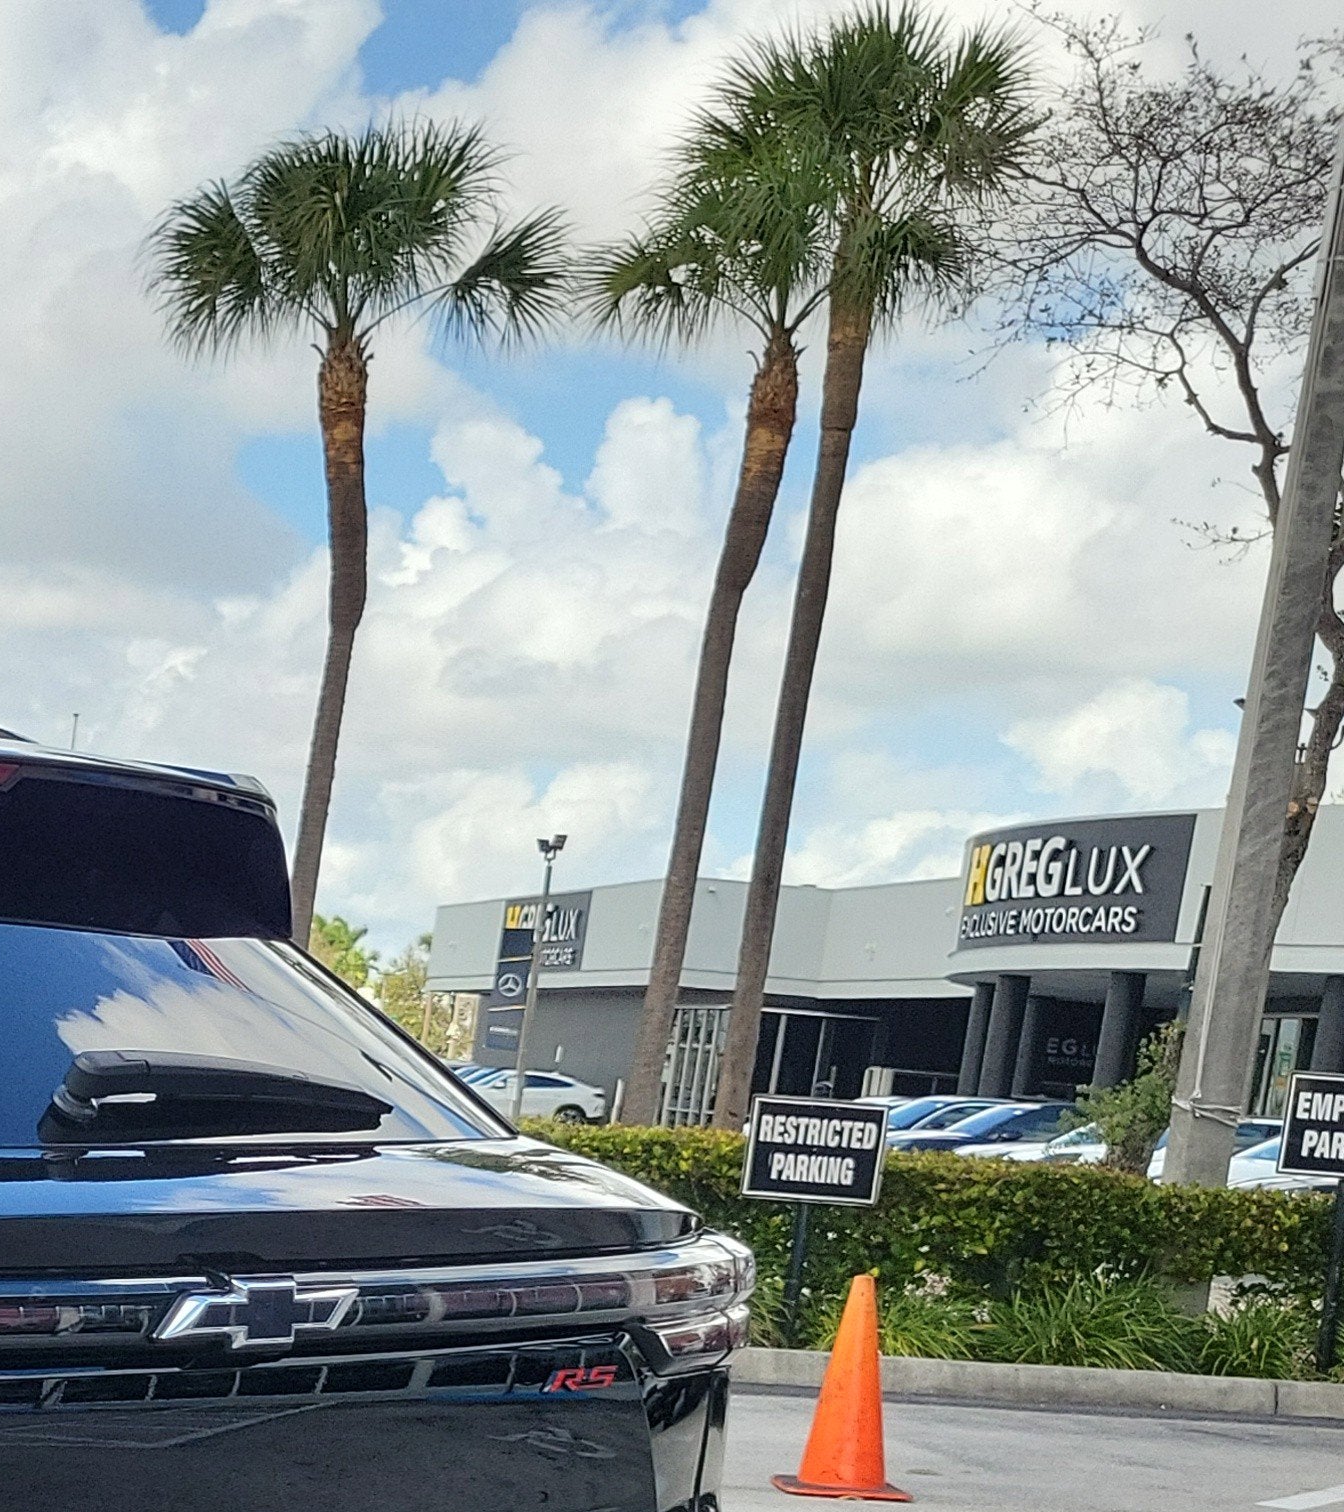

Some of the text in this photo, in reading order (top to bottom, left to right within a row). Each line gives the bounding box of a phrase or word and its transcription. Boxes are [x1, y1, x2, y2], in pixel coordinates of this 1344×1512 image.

[1019, 906, 1137, 934] MOTORCARS
[758, 1114, 879, 1150] RESTRICTED
[768, 1152, 856, 1186] PARKING
[546, 1365, 619, 1393] RS
